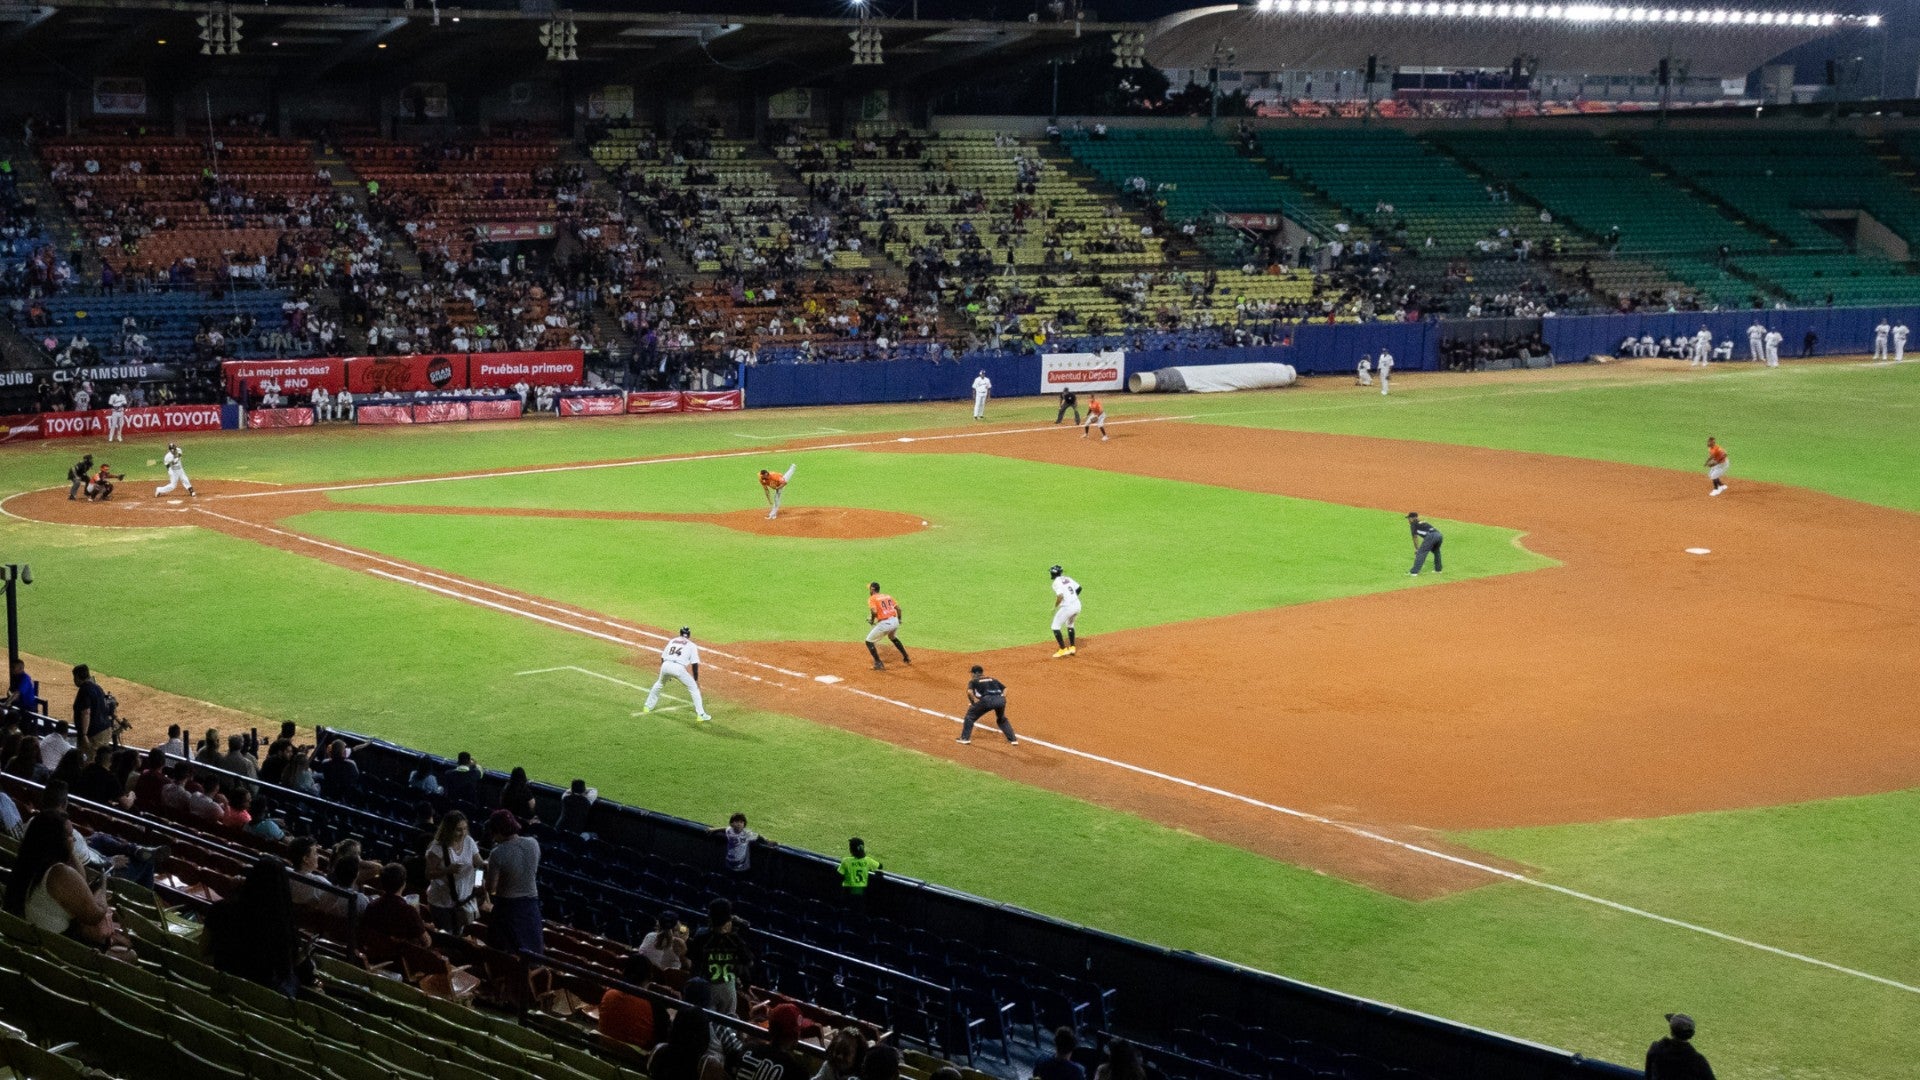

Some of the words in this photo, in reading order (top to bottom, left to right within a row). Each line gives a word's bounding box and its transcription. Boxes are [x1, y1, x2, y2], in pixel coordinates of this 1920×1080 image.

[82, 366, 147, 380] SAMSUNG
[238, 368, 254, 377] ¿La
[257, 367, 282, 377] mejor
[285, 367, 296, 375] de
[299, 366, 330, 375] todas?
[481, 363, 529, 375] Pruébala
[532, 363, 574, 375] primero
[1049, 371, 1081, 381] Juventud
[1082, 373, 1087, 381] y
[1089, 370, 1116, 381] Deporte
[284, 378, 308, 388] #NO
[47, 416, 101, 433] TOYOTA
[106, 413, 161, 429] TYOTA
[165, 411, 220, 426] TOYOTA
[669, 646, 682, 656] 84
[855, 870, 863, 883] 5
[708, 963, 735, 982] 26
